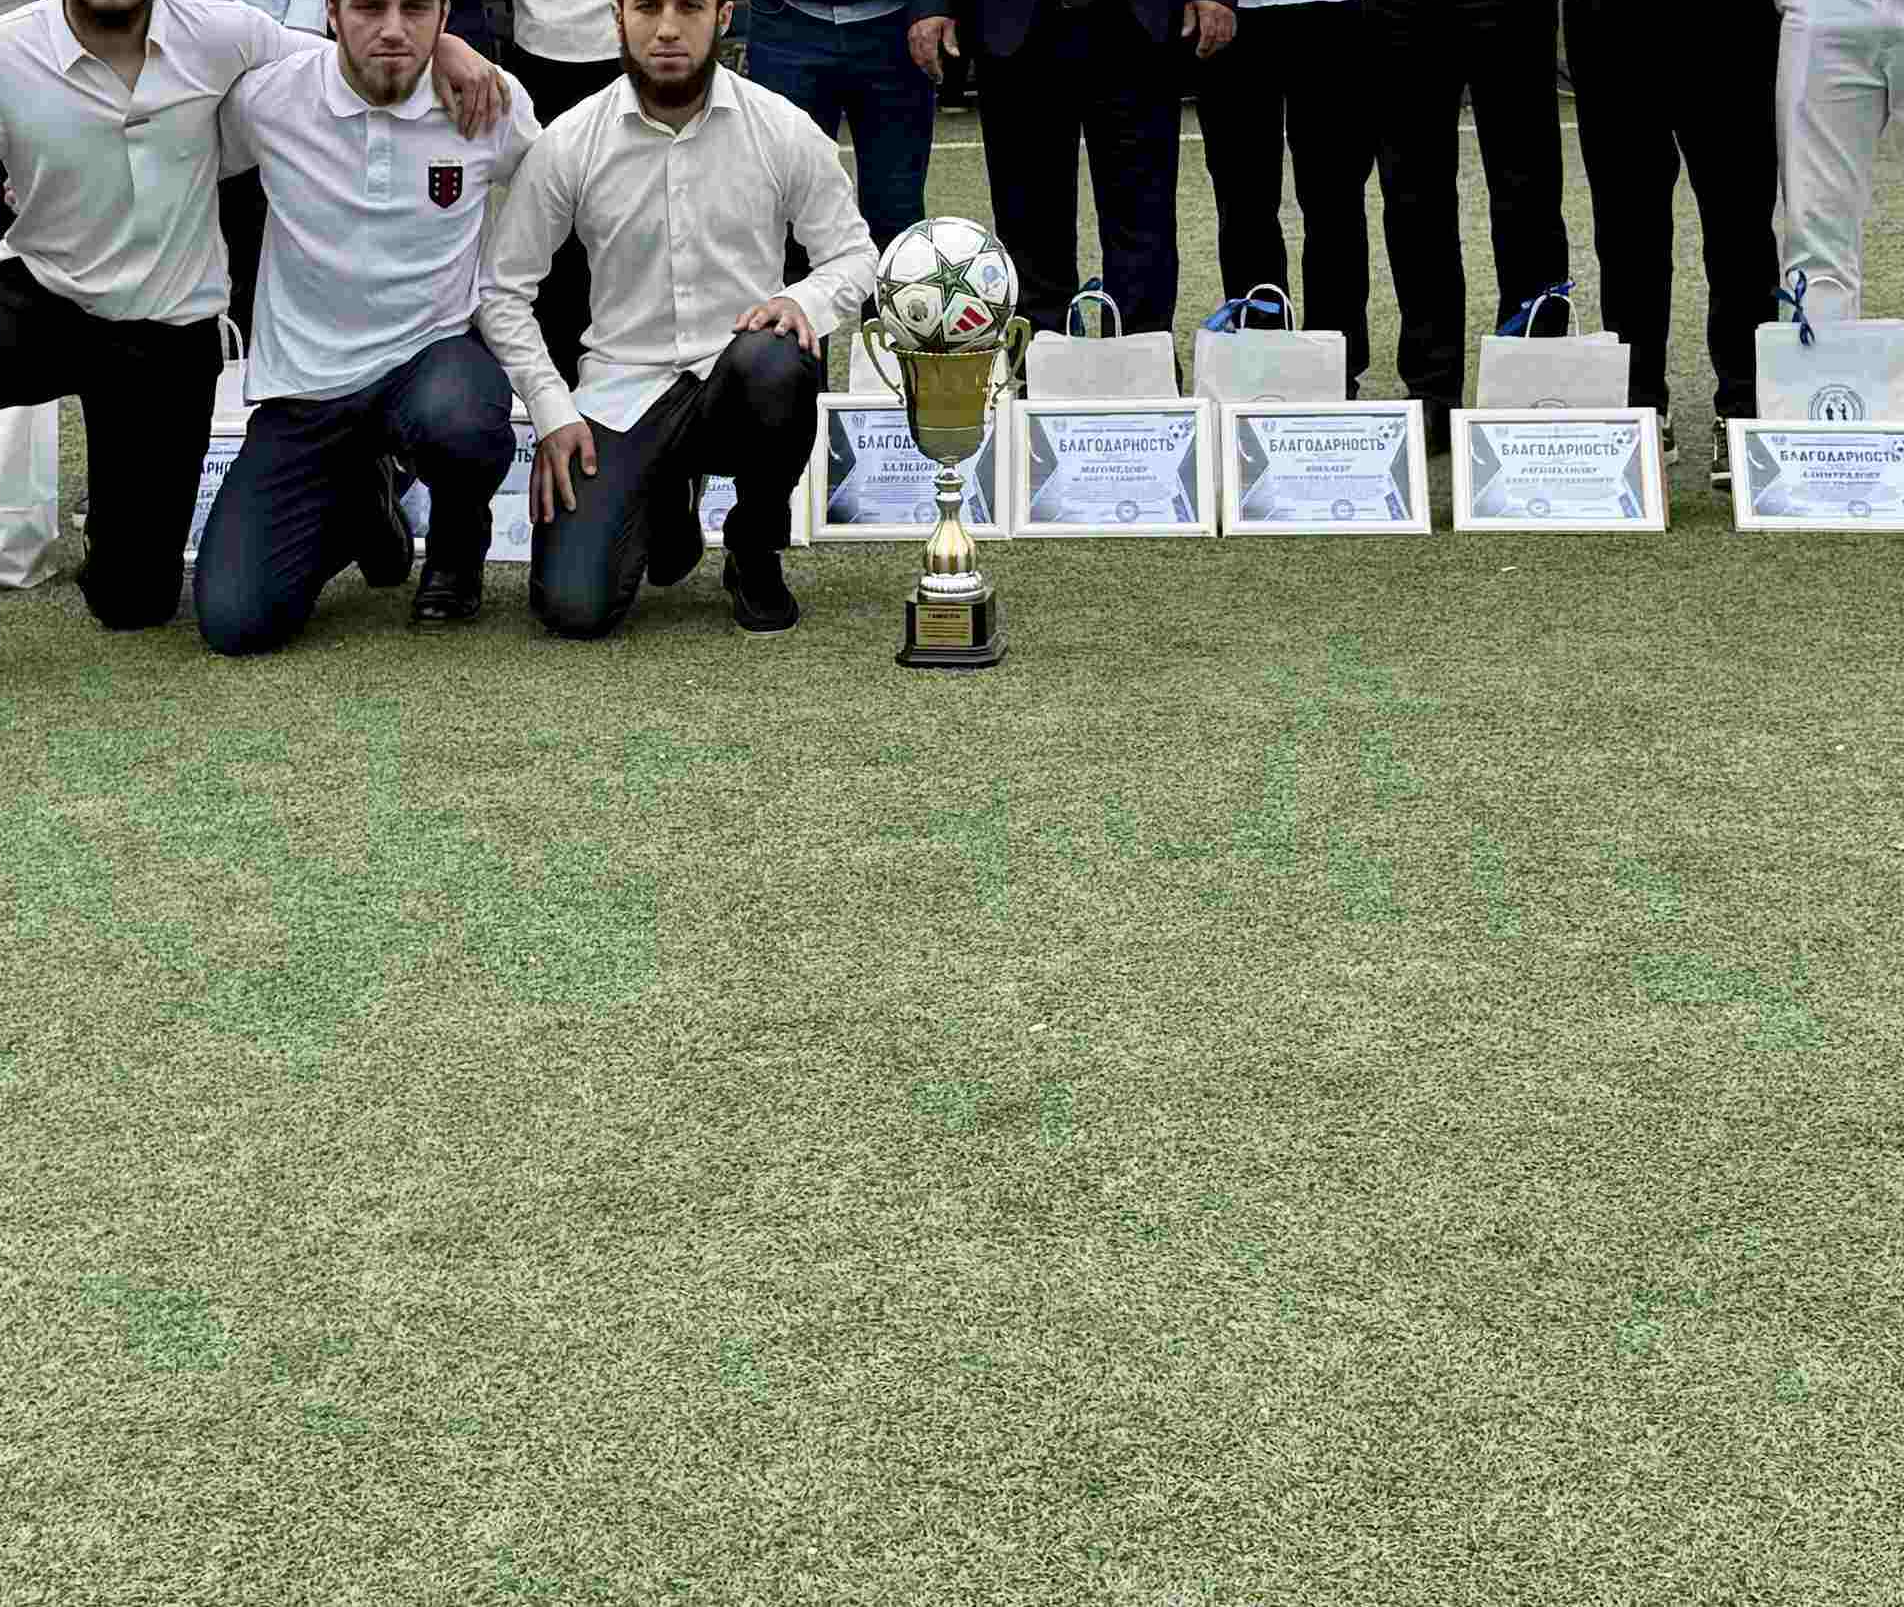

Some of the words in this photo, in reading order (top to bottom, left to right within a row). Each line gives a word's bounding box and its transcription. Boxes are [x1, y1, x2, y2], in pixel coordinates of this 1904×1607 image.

[1059, 437, 1176, 454] БЛАГОДАРНОСТЬ
[1269, 437, 1386, 453] БЛАГОДАРНОСТЬ
[1501, 442, 1620, 457] БЛАГОДАРНОСТЬ
[1779, 449, 1902, 463] БЛАГОДАРНОСТЬ
